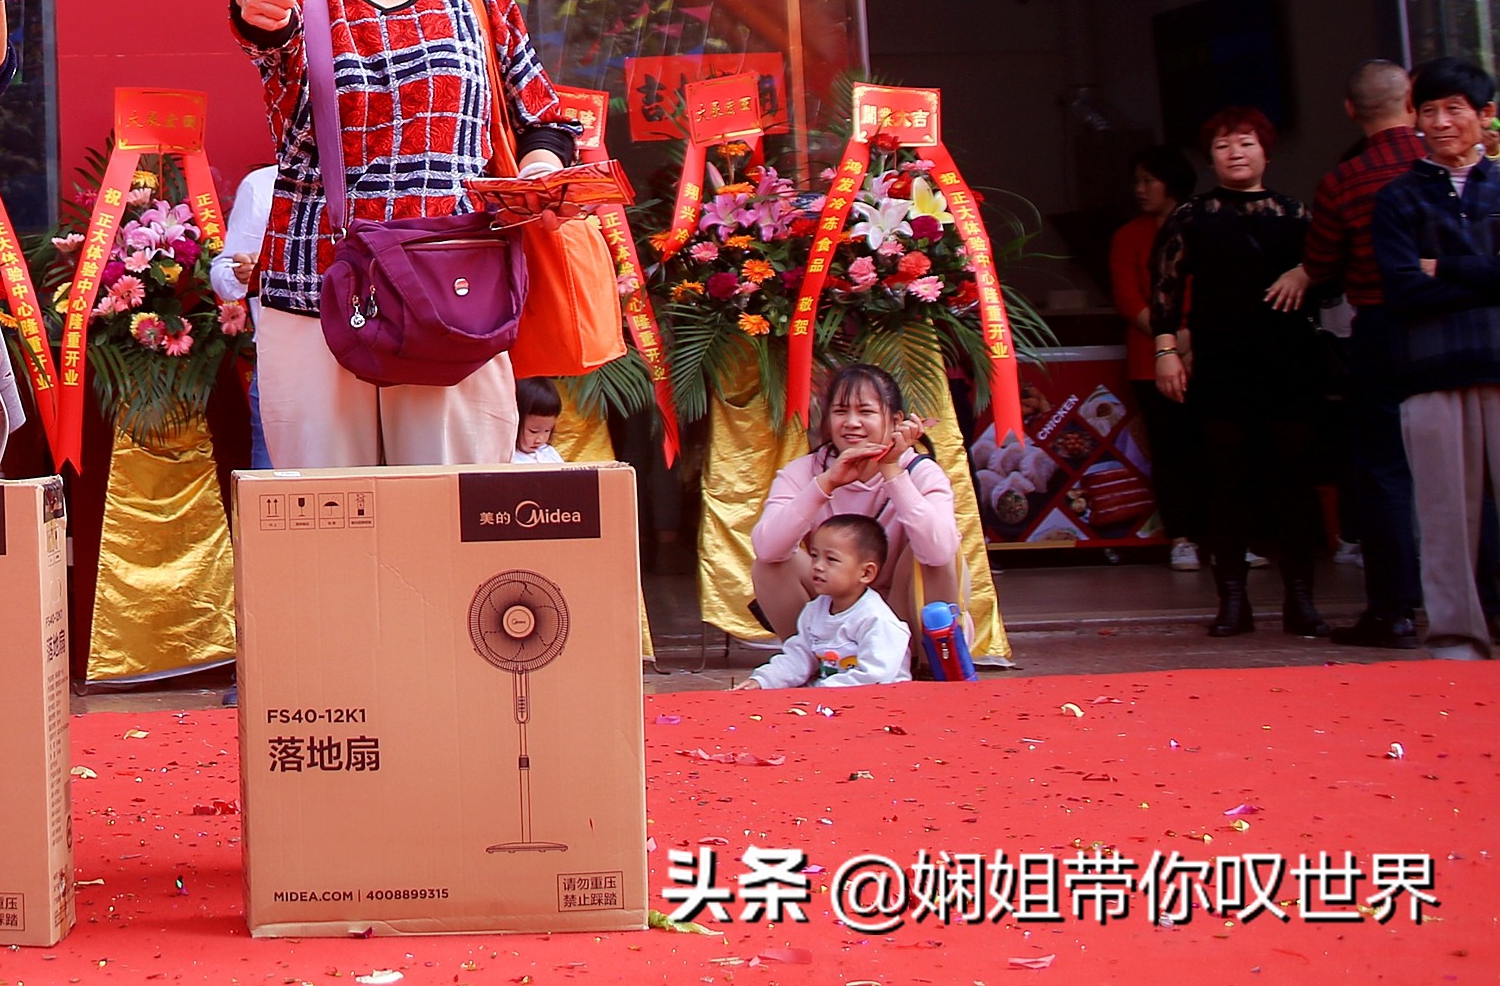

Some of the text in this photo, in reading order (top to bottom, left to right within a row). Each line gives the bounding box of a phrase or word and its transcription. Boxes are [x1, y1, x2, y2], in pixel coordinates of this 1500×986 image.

[1036, 394, 1080, 442] CHICKEN
[479, 500, 581, 528] 美的 Midea
[267, 708, 366, 724] FS40-12K1
[268, 734, 380, 773] 落地扇
[562, 875, 617, 891] 请勿重压
[273, 888, 449, 903] MIDEA.COM 4008899315
[562, 891, 617, 908] 禁止踩踏
